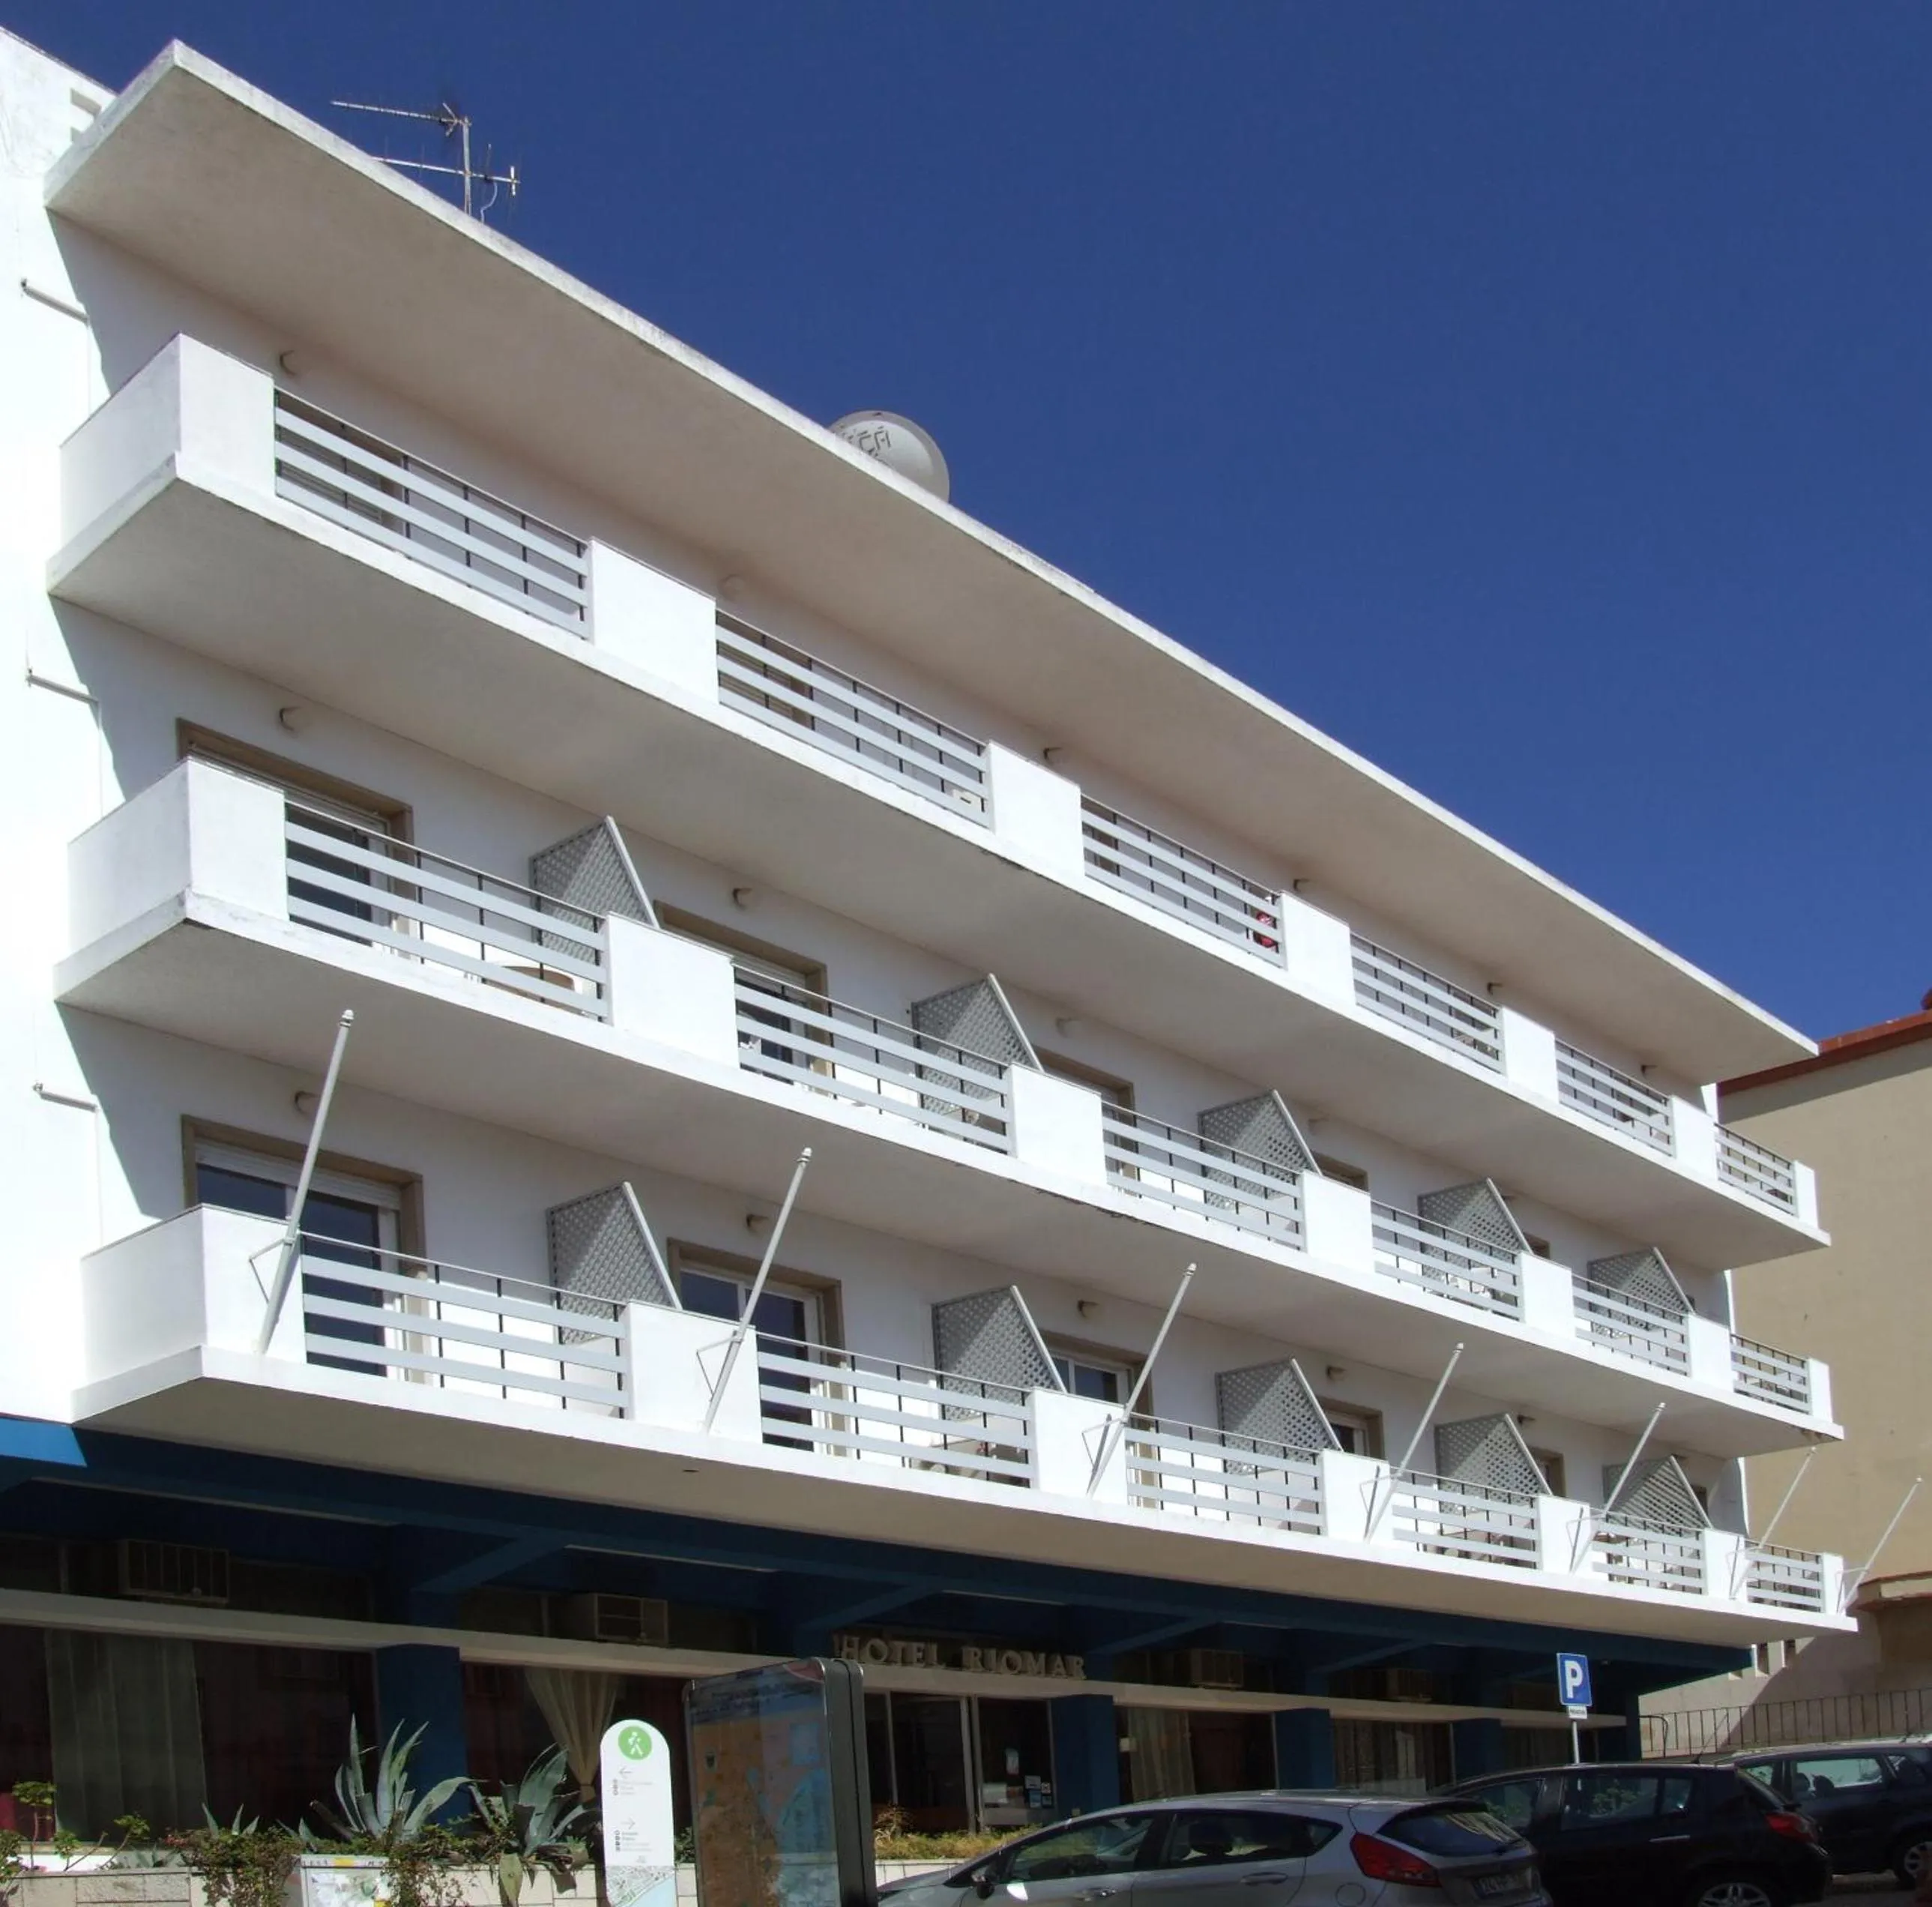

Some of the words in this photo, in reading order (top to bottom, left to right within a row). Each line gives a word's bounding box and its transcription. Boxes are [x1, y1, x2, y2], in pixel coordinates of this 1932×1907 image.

[833, 1633, 946, 1669] HOTEL
[962, 1645, 1087, 1681] RIOMAR
[1565, 1660, 1583, 1699] P
